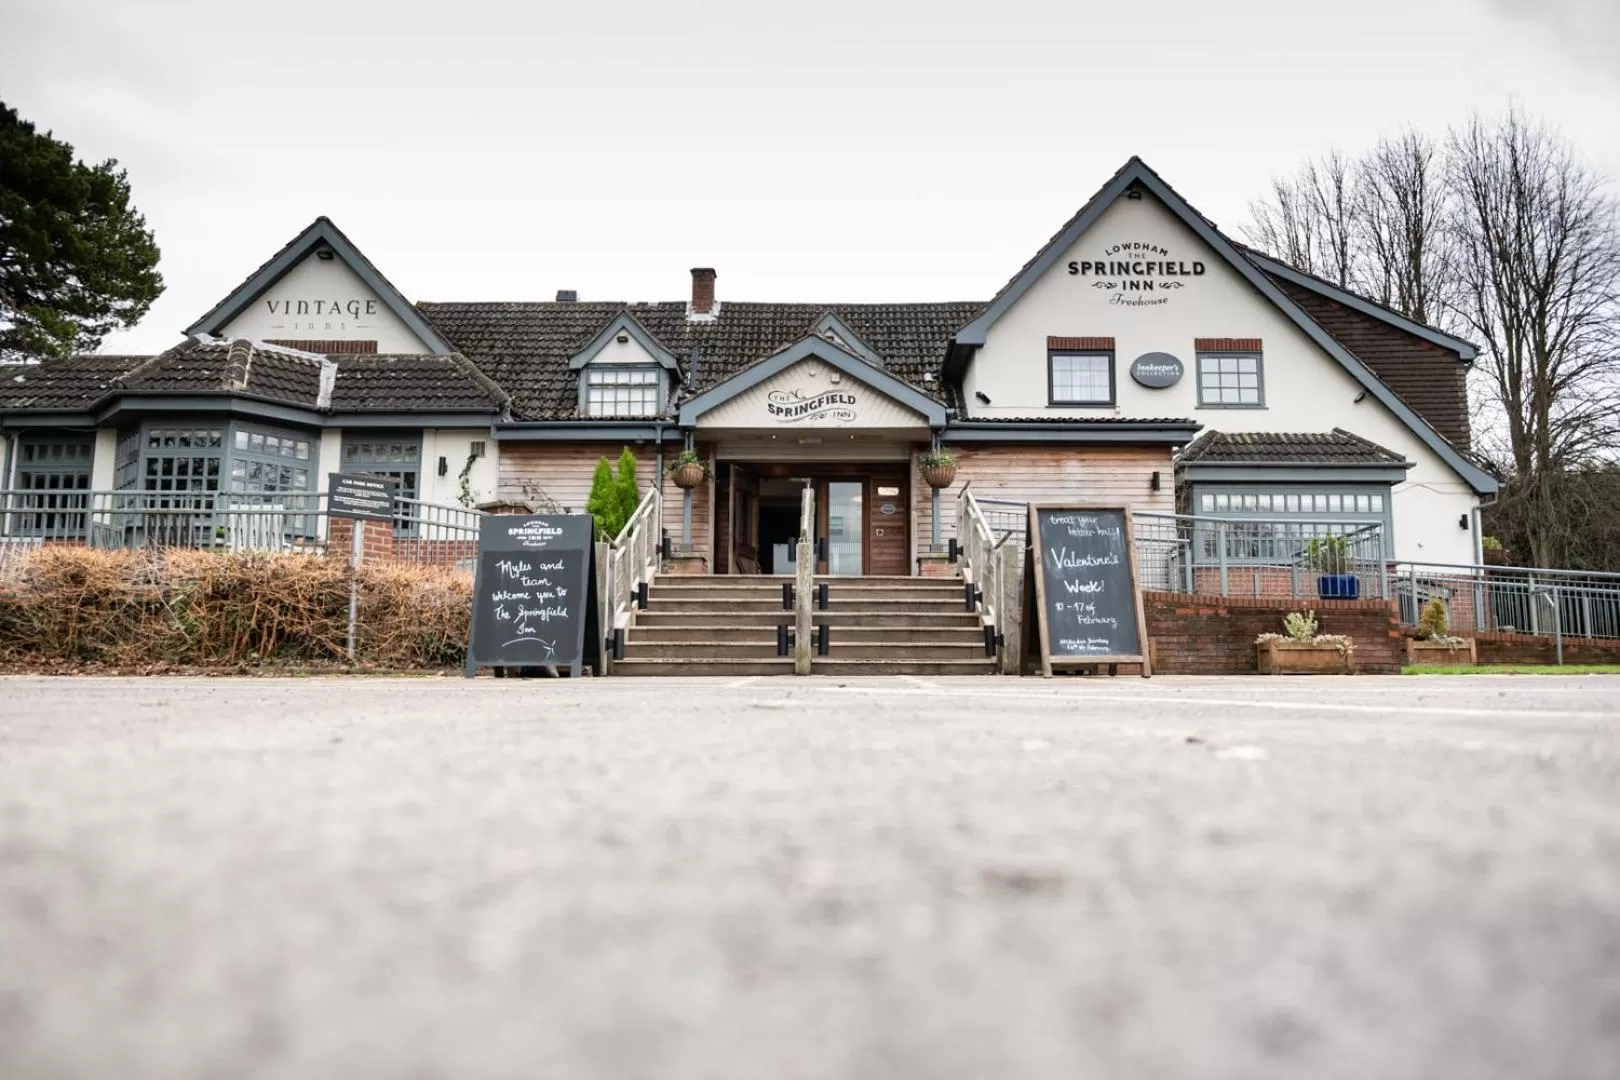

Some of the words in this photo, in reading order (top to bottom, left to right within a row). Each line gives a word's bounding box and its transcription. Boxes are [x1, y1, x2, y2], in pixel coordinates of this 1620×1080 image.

[1105, 242, 1168, 257] LOWDHAM
[1068, 261, 1206, 276] SPRINGFIELD
[1122, 280, 1154, 291] INN
[1109, 293, 1168, 306] Treehouse
[267, 300, 377, 319] VINTAGE
[767, 394, 856, 417] SPRINGFIELD
[508, 527, 563, 536] SPRINGFIELD
[540, 559, 565, 570] and
[1051, 547, 1119, 569] Valentine's
[521, 577, 552, 586] team
[492, 591, 531, 601] welcome
[536, 592, 556, 604] you
[556, 587, 568, 596] to
[513, 604, 568, 624] Springfield
[516, 623, 536, 634] Inn
